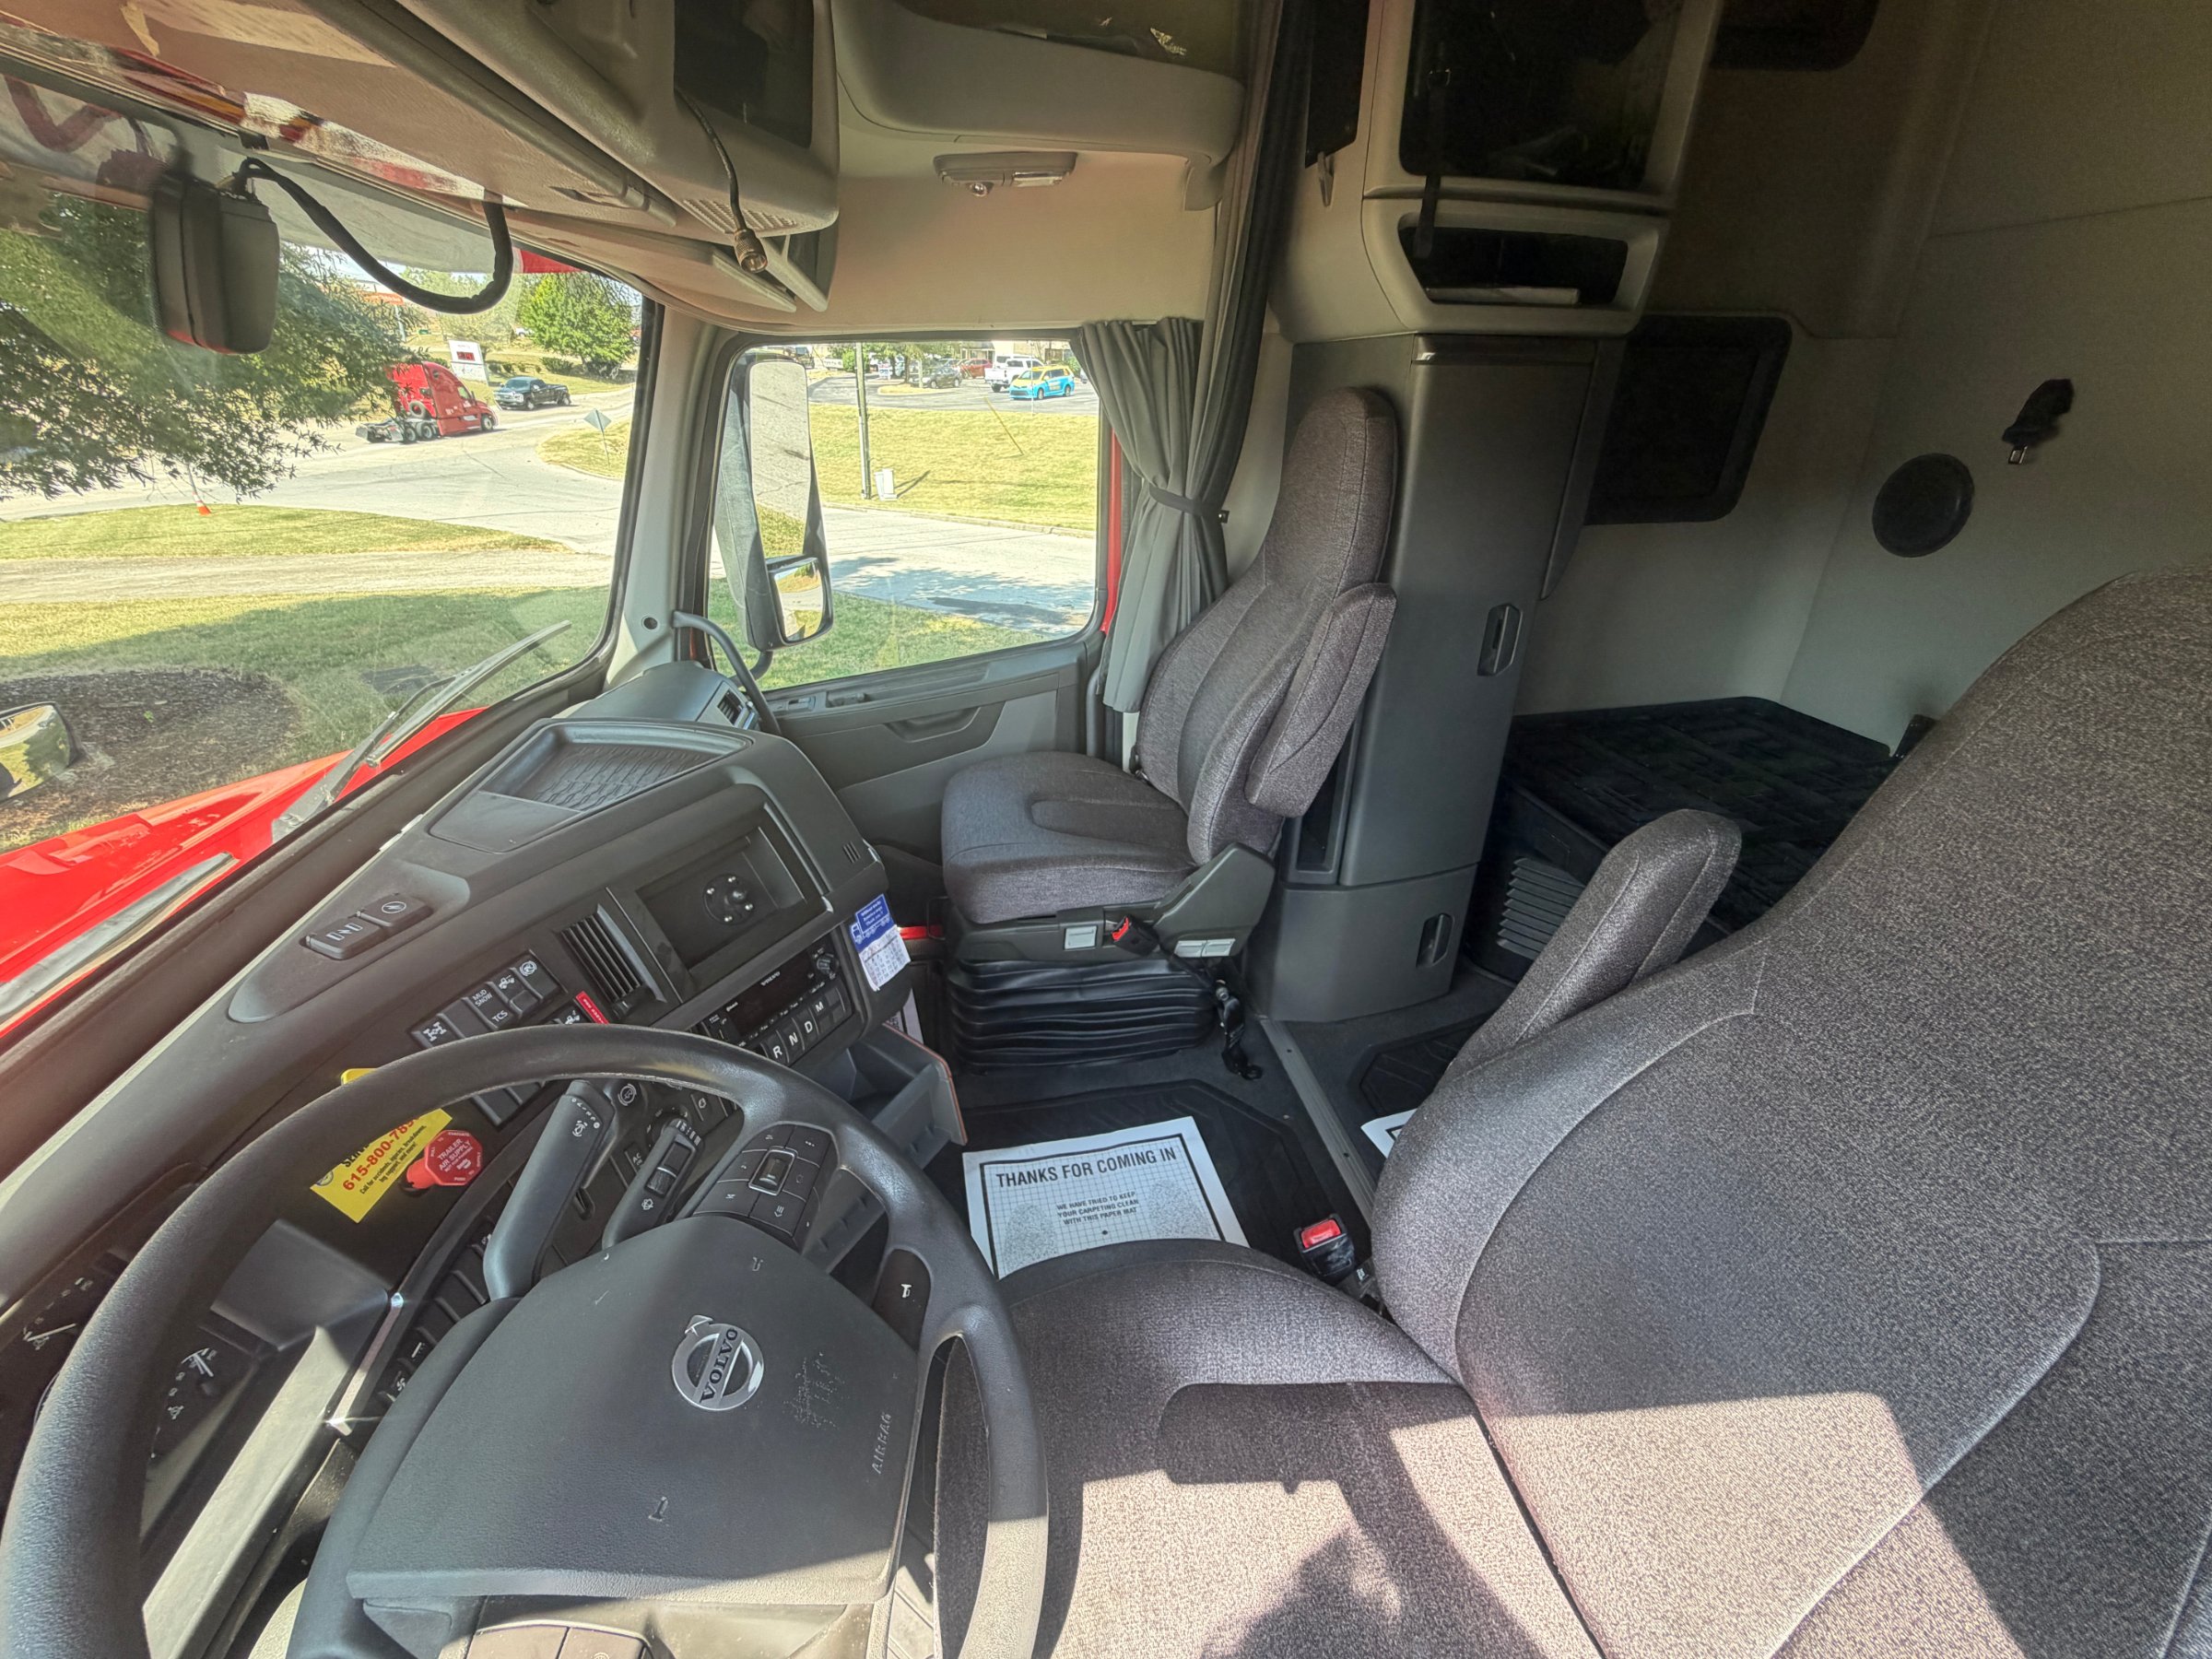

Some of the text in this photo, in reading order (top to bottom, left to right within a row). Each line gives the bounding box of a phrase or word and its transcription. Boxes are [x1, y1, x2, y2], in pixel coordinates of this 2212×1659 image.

[472, 989, 487, 1001] MUD
[474, 992, 492, 1006] SNOW
[815, 1001, 824, 1013] M
[492, 1010, 508, 1023] TCS
[772, 1021, 813, 1058] R N D
[399, 1152, 407, 1161] and
[437, 1138, 463, 1159] TRAILER
[439, 1140, 471, 1171] AIR SUPPLY
[996, 1147, 1177, 1189] THANKS FOR COMING IN
[359, 1184, 370, 1194] Call
[373, 1162, 392, 1181] accidents,
[1069, 1201, 1088, 1209] HAVE
[1088, 1197, 1108, 1206] TRIED
[1119, 1191, 1135, 1199] KEEP
[1078, 1204, 1117, 1215] CARPETING
[1117, 1199, 1139, 1207] CLEAN
[1064, 1217, 1082, 1225] WITH
[1100, 1210, 1123, 1218] PAPER
[700, 1327, 739, 1404] VOLVO
[871, 1412, 893, 1475] AIRBAG
